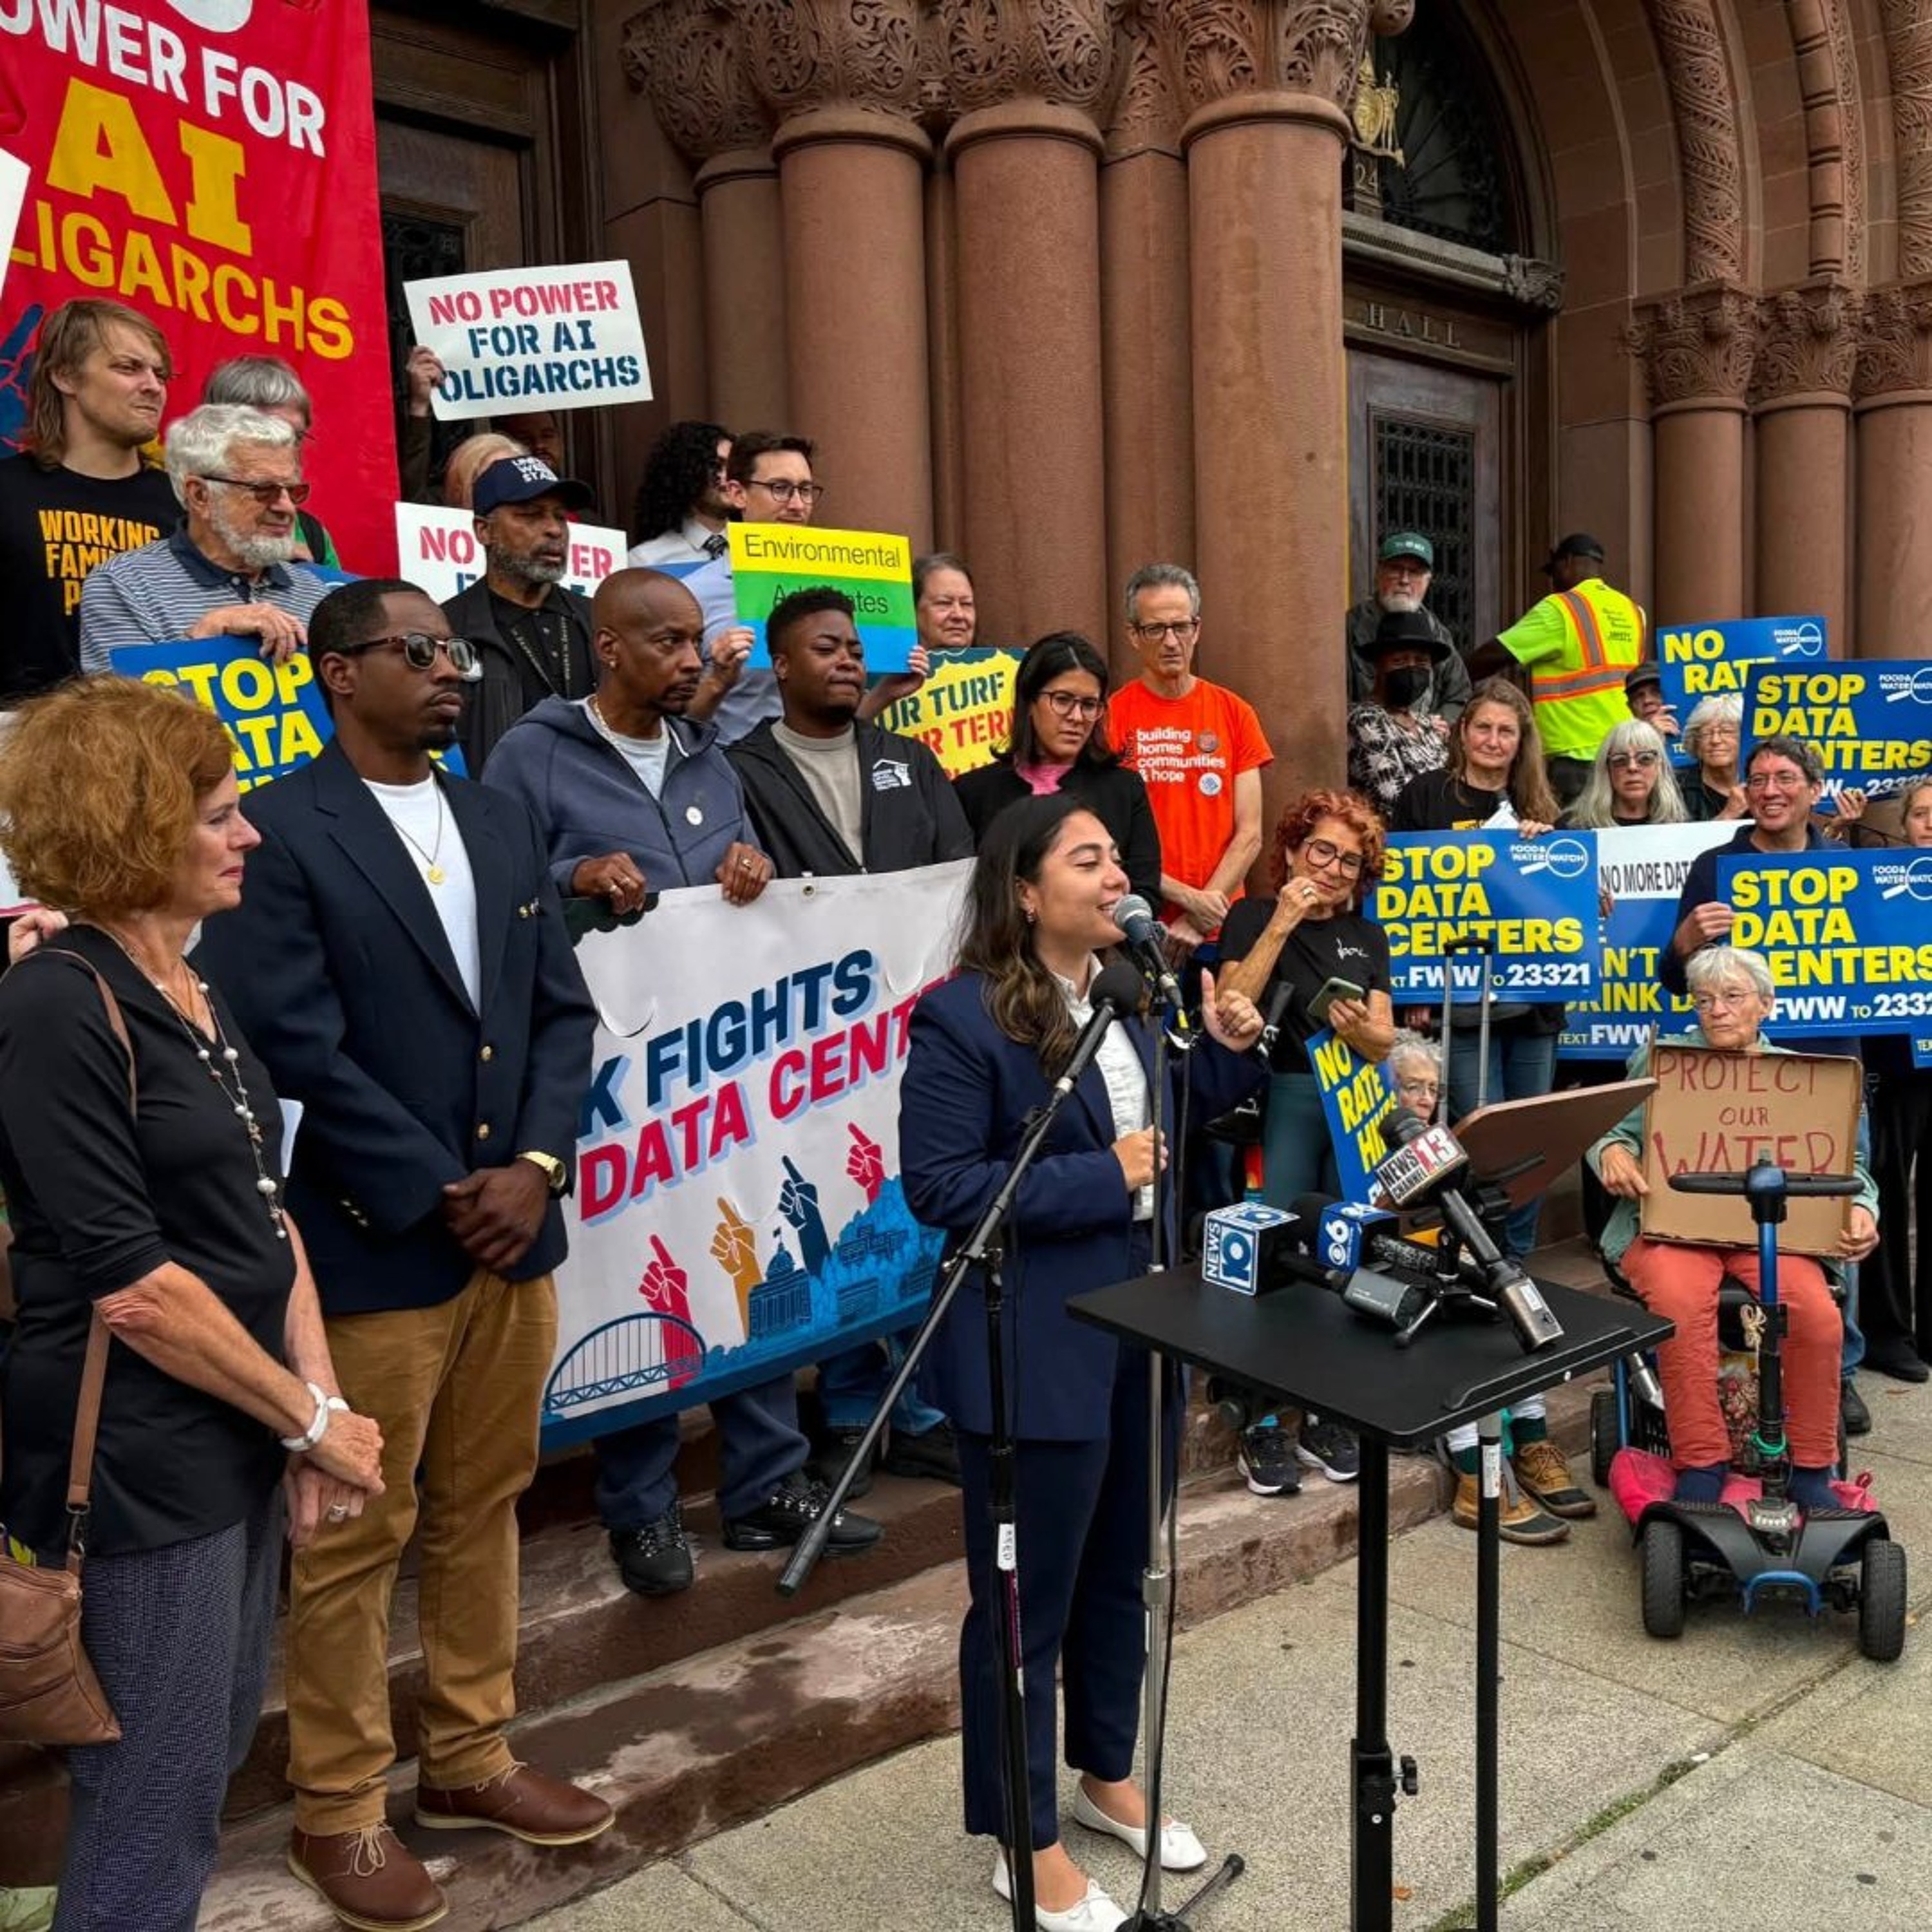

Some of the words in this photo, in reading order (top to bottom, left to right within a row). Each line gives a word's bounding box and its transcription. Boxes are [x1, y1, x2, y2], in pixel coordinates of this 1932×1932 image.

[201, 47, 325, 158] FOR
[46, 76, 252, 257] AI
[1355, 162, 1378, 197] 24
[9, 200, 354, 359] IGARCHS
[428, 290, 482, 326] NO
[489, 279, 620, 321] POWER
[468, 323, 541, 359] FOR
[553, 319, 596, 354] AI
[1367, 302, 1461, 348] HALL
[439, 355, 641, 403] OLIGARCHS
[419, 526, 476, 565] NO
[744, 533, 902, 569] Environmental
[1663, 629, 1725, 663] NO
[141, 652, 314, 711] TOP
[927, 671, 1005, 717] TURF
[1683, 657, 1776, 694] RAT
[1756, 673, 1866, 705] STOP
[949, 706, 1015, 748] TER
[1136, 726, 1191, 744] building
[1752, 706, 1858, 737] DATA
[1137, 741, 1184, 756] homes
[1137, 753, 1226, 768] communities
[1806, 739, 1932, 771] NTERS
[1151, 767, 1186, 782] hope
[1381, 844, 1495, 882] STOP
[1600, 865, 1622, 893] NO
[1623, 861, 1663, 893] MORE
[1663, 858, 1696, 890] DAT
[1377, 883, 1493, 920] DATA
[1730, 866, 1859, 908] STOP
[1385, 917, 1584, 956] CENTERS
[1730, 907, 1857, 947] DATA
[1408, 965, 1481, 988] FWW
[1506, 963, 1591, 987] 23321
[1600, 947, 1660, 978] N'T
[1768, 944, 1932, 987] ENTERS
[1564, 981, 1663, 1012] INK
[1768, 996, 1847, 1021] FWW
[1850, 1005, 1872, 1019] TO
[647, 949, 876, 1109] FIGHTS
[1314, 1035, 1352, 1092] NO
[1655, 1050, 1821, 1096] PROTECT
[579, 1080, 754, 1226] DATA
[768, 965, 963, 1121] CENT
[1336, 1063, 1385, 1134] RATE
[1718, 1106, 1769, 1127] OUR
[1379, 1146, 1419, 1187] NEWS
[1414, 1126, 1461, 1168] 13
[1652, 1130, 1835, 1177] WATER
[1390, 1166, 1428, 1200] CHANNEL
[1206, 1222, 1221, 1278] NEWS
[1221, 1231, 1252, 1282] 10
